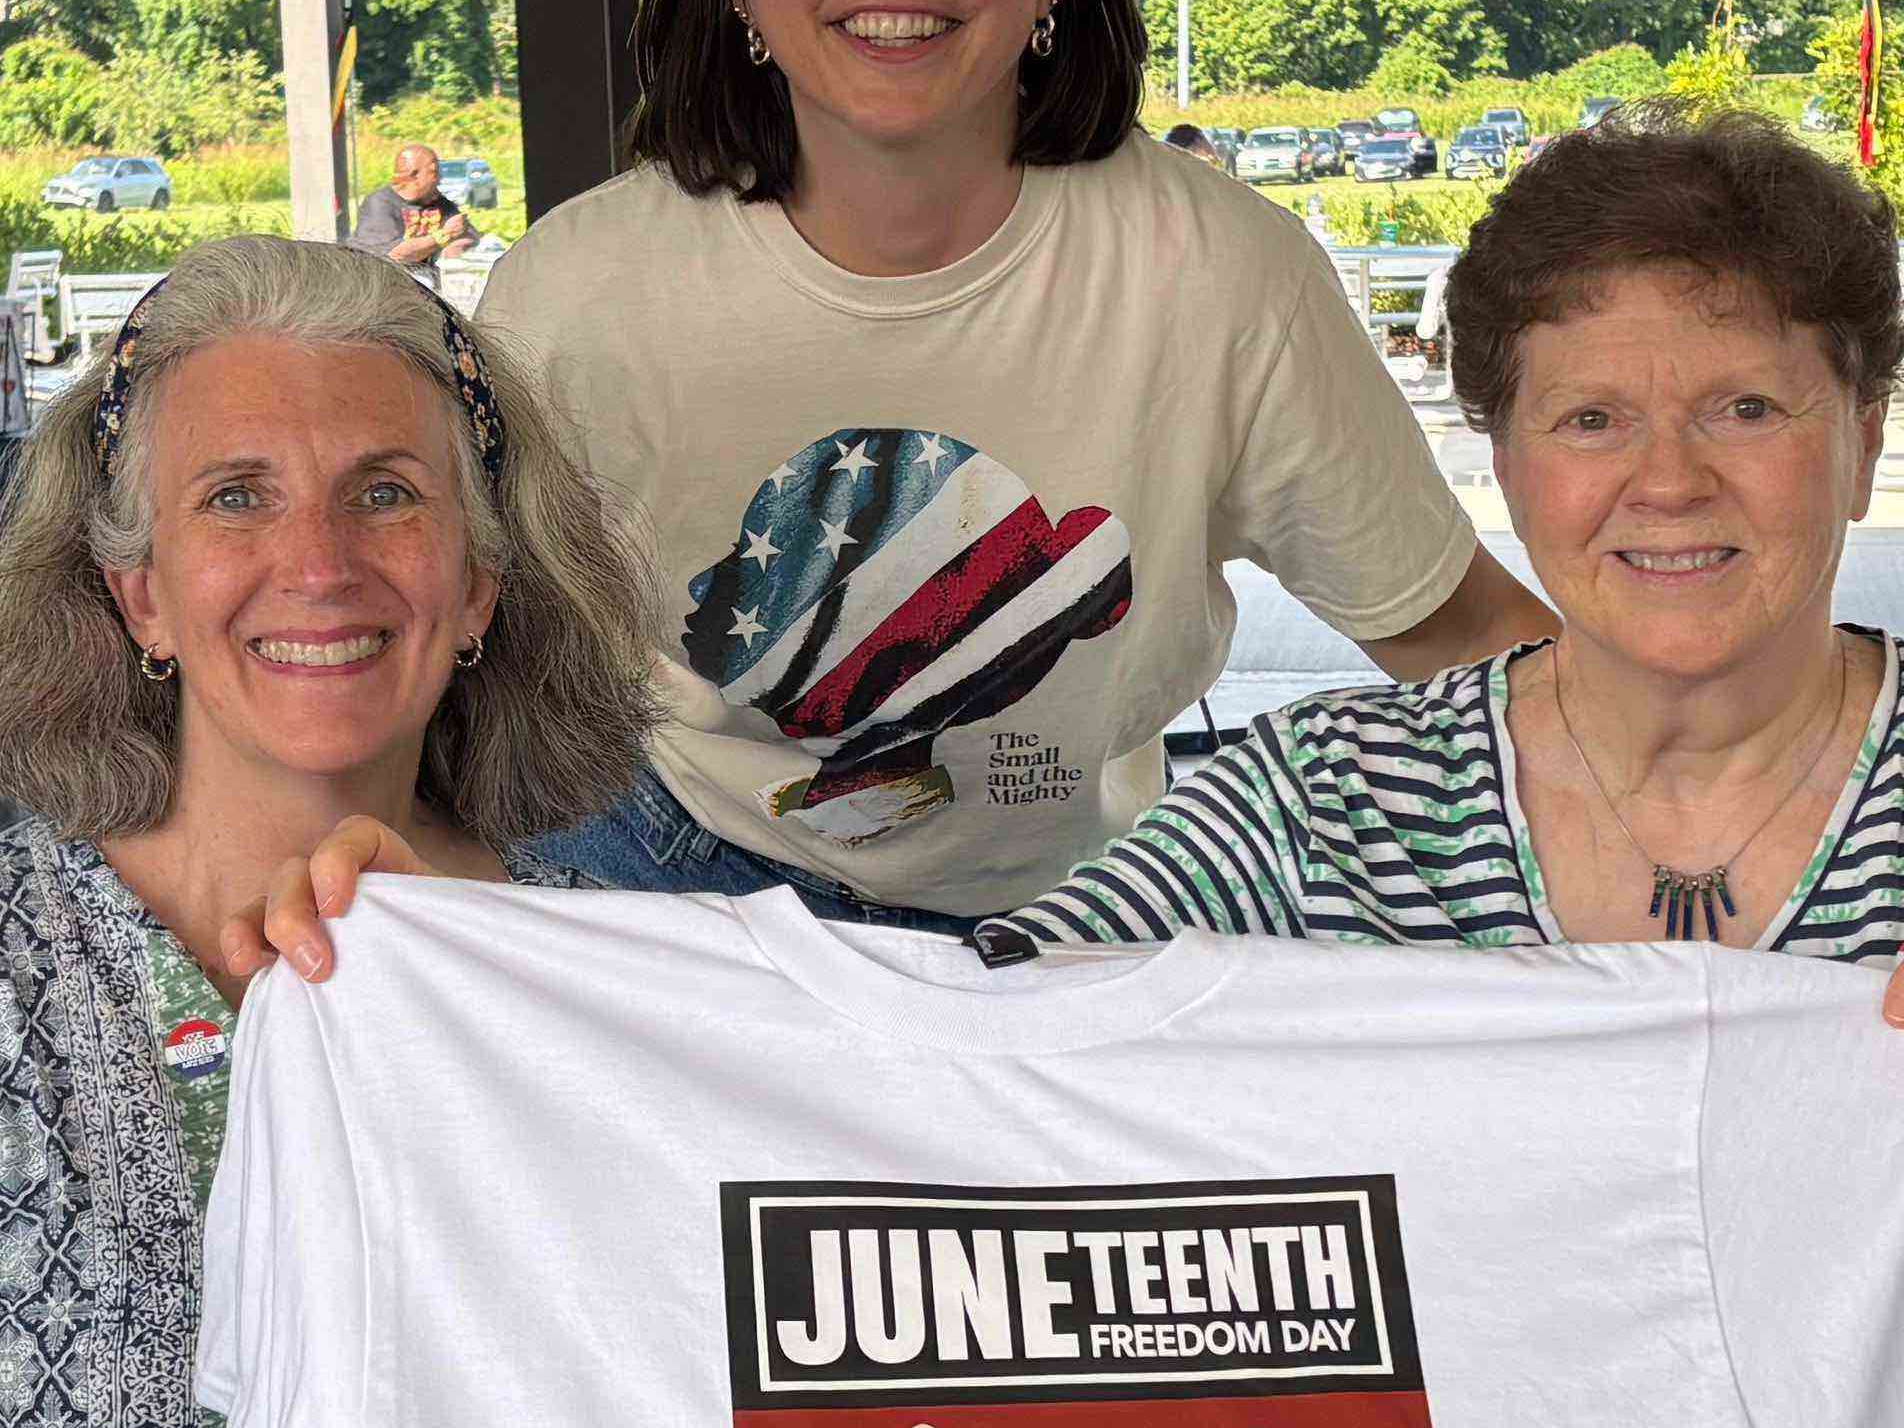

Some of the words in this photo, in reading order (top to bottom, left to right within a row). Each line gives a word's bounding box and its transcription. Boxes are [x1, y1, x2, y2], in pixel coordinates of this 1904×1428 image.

[991, 730, 1040, 749] The
[989, 747, 1059, 769] Small
[986, 768, 1037, 787] and
[1041, 764, 1083, 783] the
[986, 783, 1077, 806] Mighty
[776, 1224, 1356, 1366] JUNETEENTH
[1089, 1319, 1272, 1359] FREEDOM
[1280, 1317, 1356, 1354] DAY
